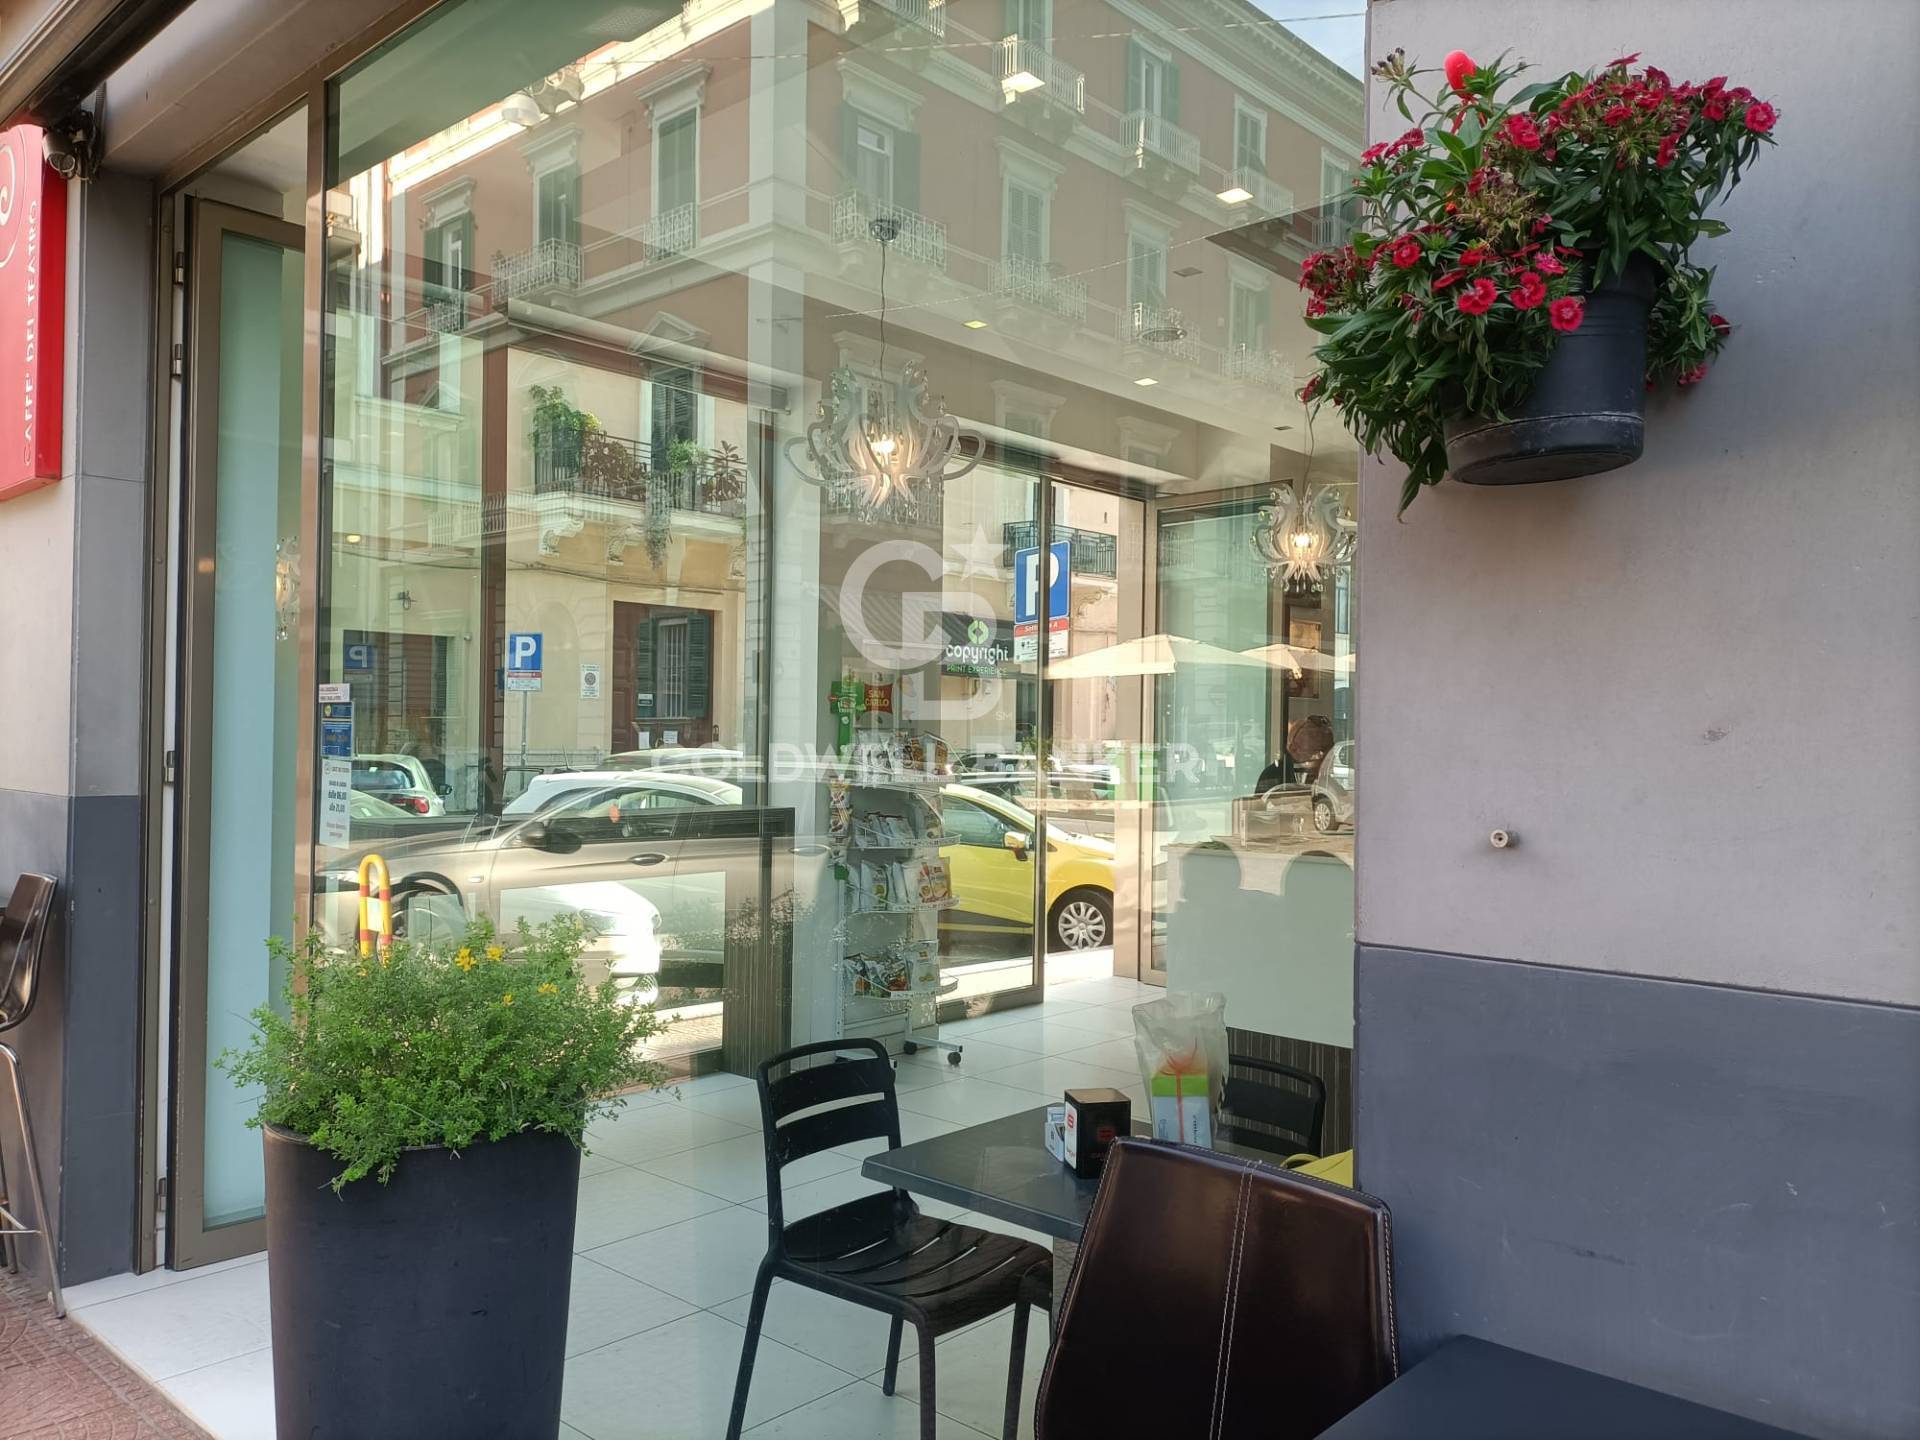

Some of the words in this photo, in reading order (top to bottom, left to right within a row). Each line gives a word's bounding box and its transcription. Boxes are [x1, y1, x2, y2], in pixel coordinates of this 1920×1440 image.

[26, 200, 37, 308] TEATRO
[25, 315, 35, 363] DEL
[514, 636, 537, 668] P
[945, 643, 1009, 664] copyright
[867, 689, 885, 698] SAN
